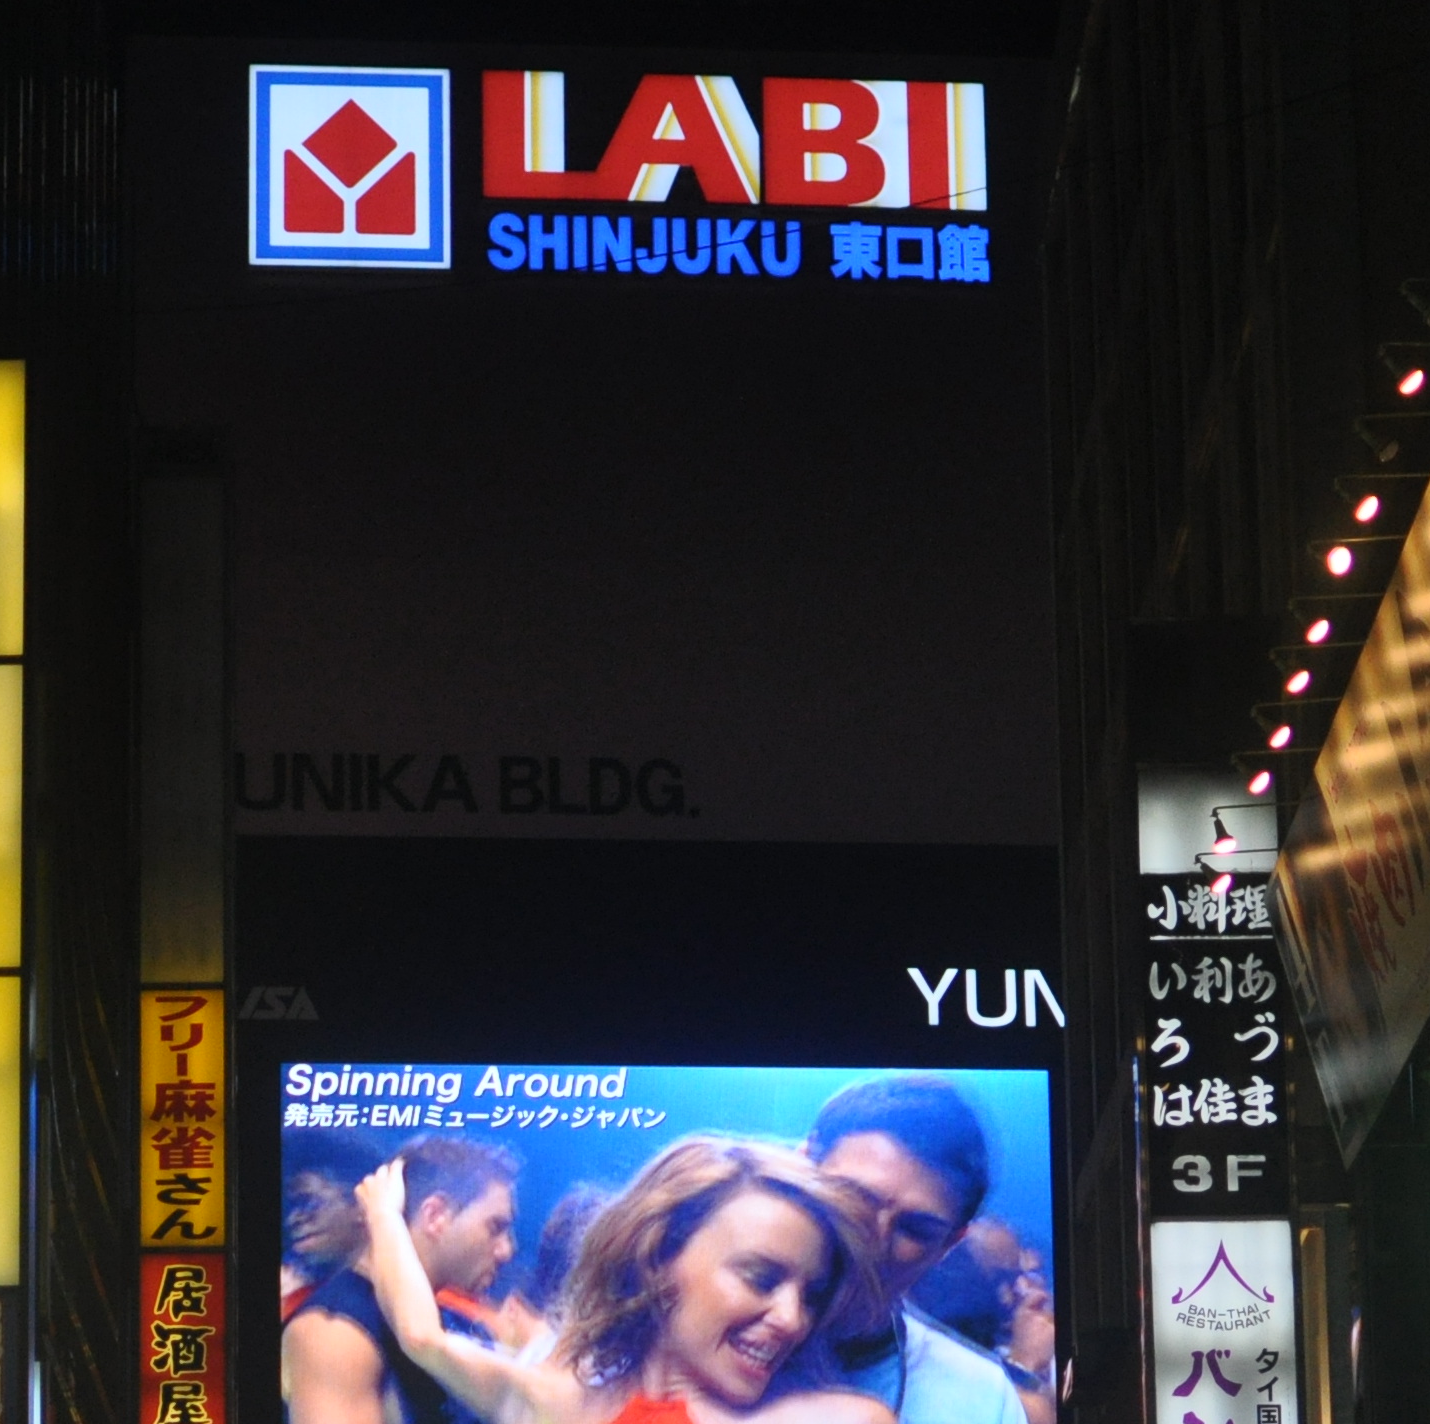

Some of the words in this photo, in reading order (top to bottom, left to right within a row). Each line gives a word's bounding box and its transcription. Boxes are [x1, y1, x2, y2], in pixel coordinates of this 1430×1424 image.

[482, 69, 988, 211] LABI
[486, 212, 803, 278] SHINJUKU
[830, 221, 992, 284] 東口館
[500, 755, 701, 817] BLDG.
[1147, 884, 1272, 934] 小料理
[285, 1065, 464, 1106] Spinning
[474, 1066, 626, 1100] Around
[150, 995, 219, 1242] フリー麻雀さん
[1172, 1154, 1268, 1193] 3F
[1175, 1309, 1272, 1332] RESTAURANT
[1187, 1302, 1260, 1321] BAN-THAI
